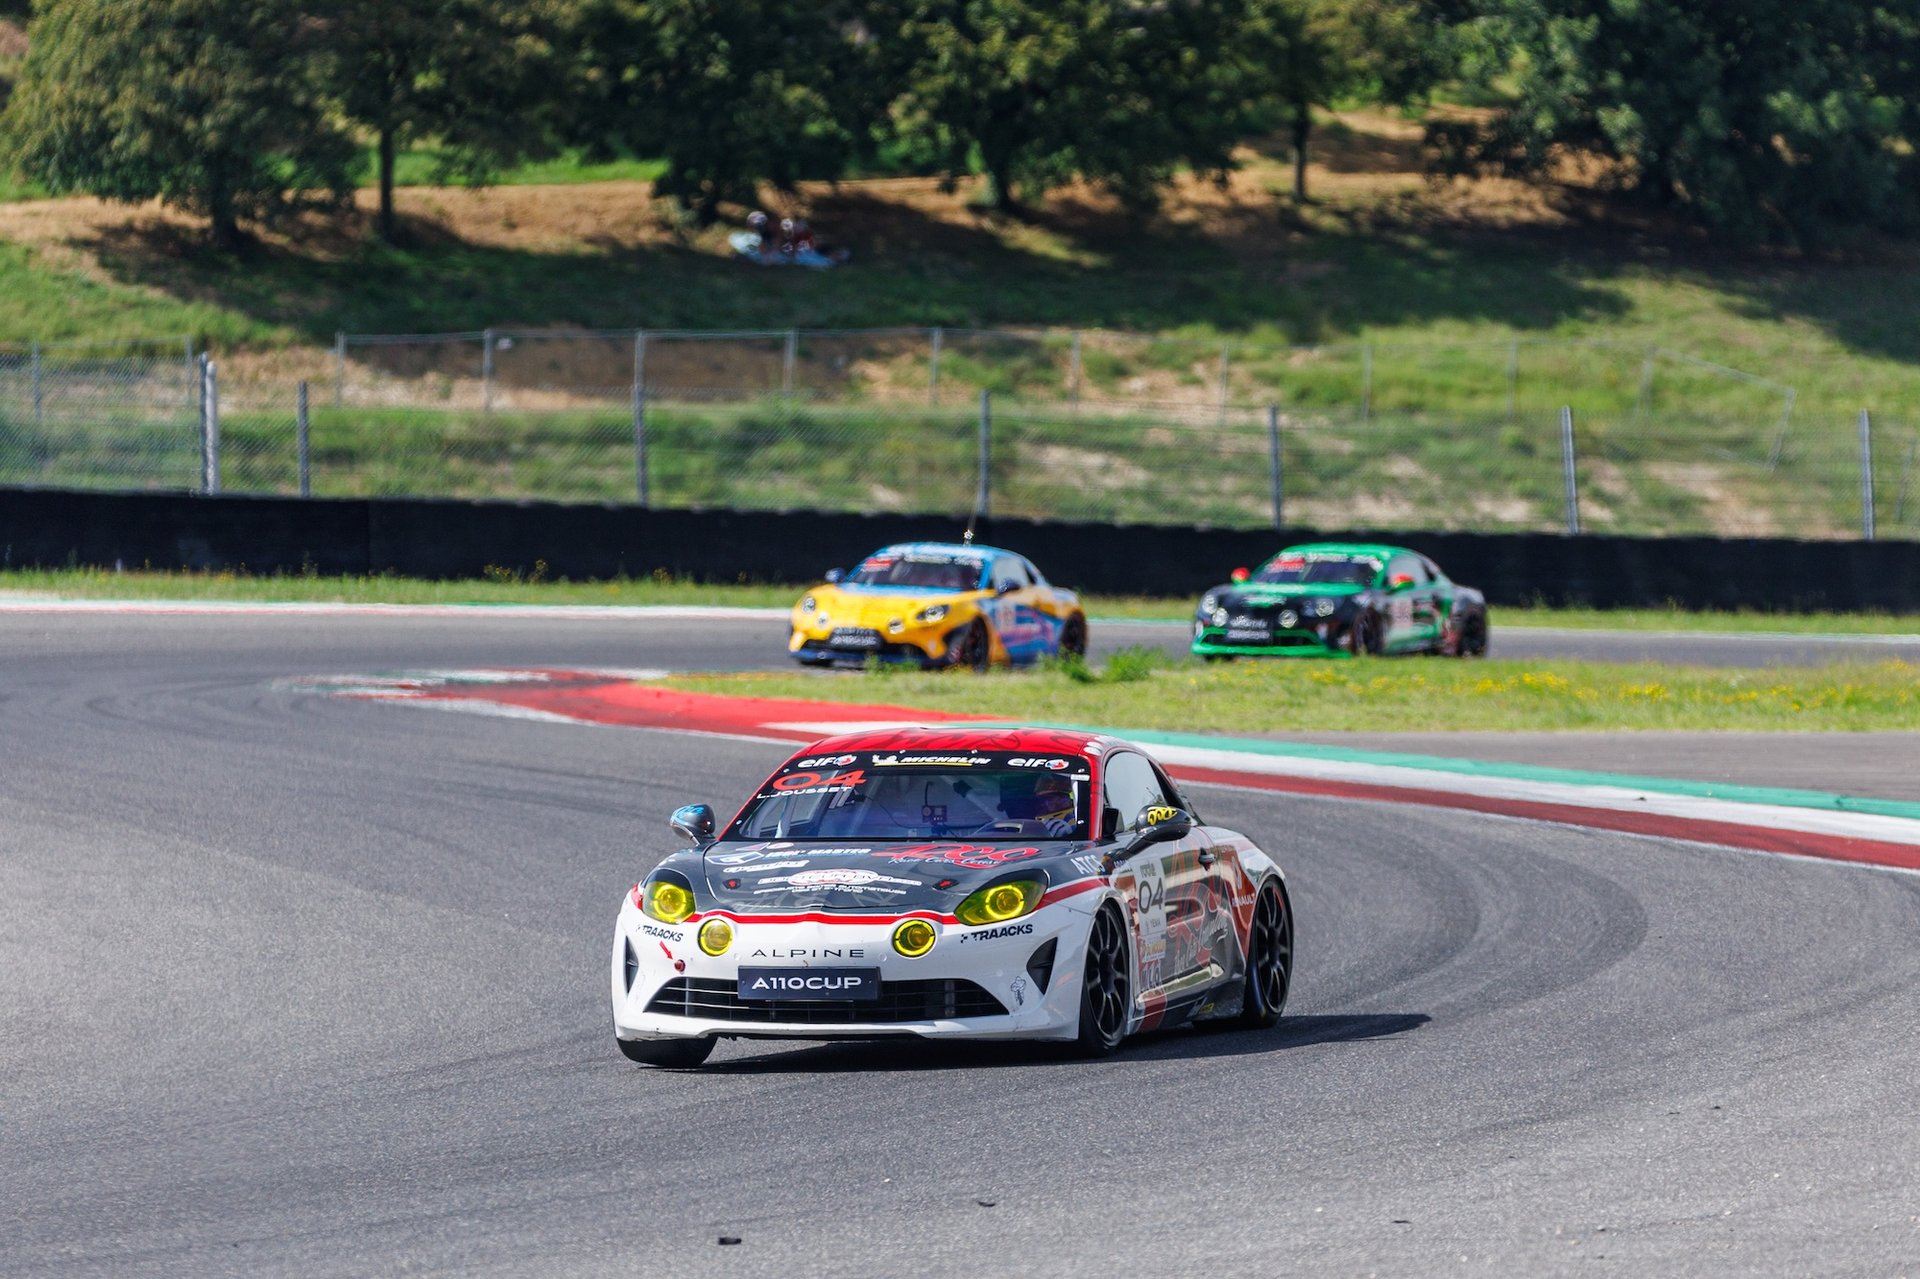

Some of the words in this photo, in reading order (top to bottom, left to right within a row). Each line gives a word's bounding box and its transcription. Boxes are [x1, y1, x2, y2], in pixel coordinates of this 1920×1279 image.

[900, 756, 992, 765] MICHELIN
[772, 769, 867, 791] 04
[1138, 877, 1164, 914] 04
[643, 924, 684, 942] TRAACKS
[971, 923, 1034, 941] TRAACKS
[751, 949, 865, 958] ALPINE
[751, 976, 862, 990] A110CUP
